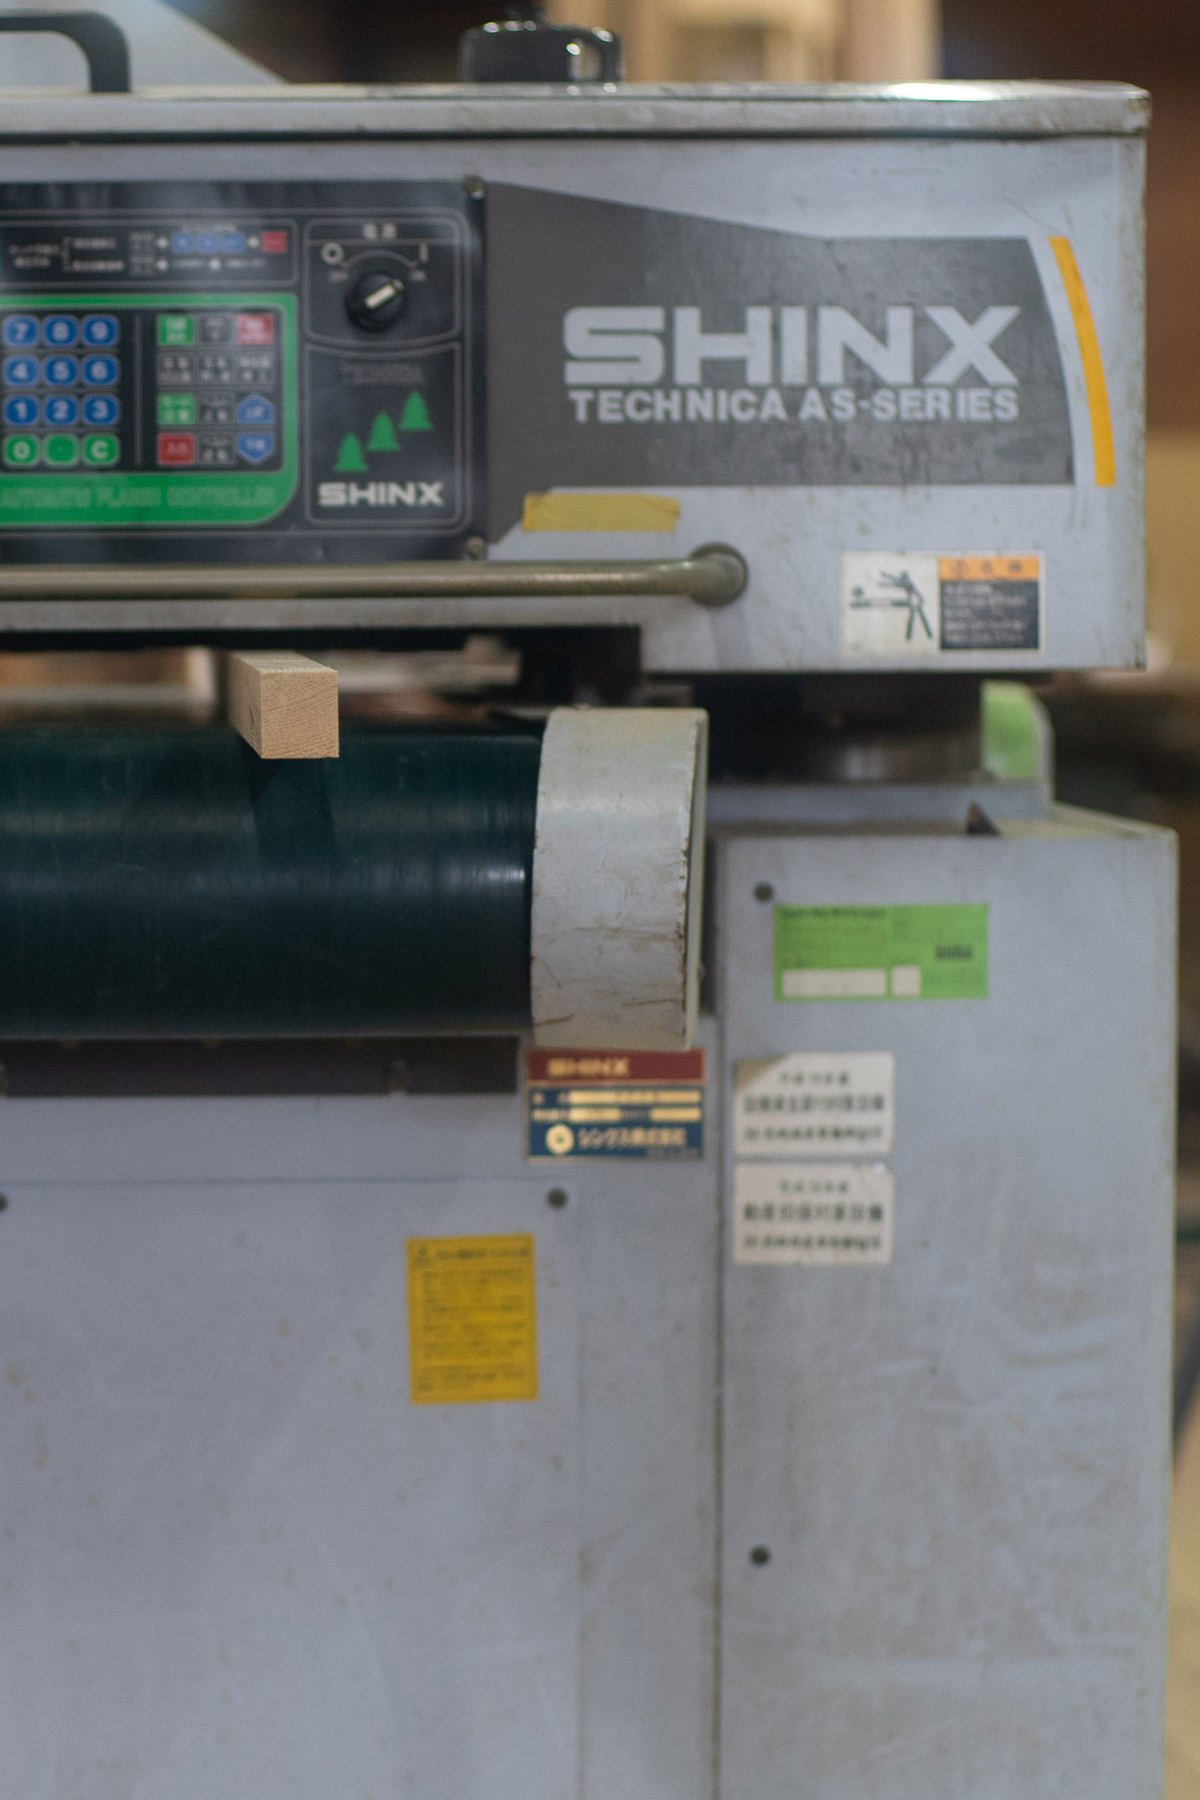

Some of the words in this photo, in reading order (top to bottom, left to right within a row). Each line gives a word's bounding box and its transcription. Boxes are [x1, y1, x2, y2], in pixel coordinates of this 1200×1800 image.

[14, 322, 29, 341] 7
[52, 321, 70, 342] 8
[91, 321, 109, 341] 9
[563, 305, 1020, 385] SHINX
[13, 361, 29, 380] 4
[53, 360, 70, 381] 5
[91, 361, 109, 381] 6
[15, 402, 28, 420] 1
[53, 400, 70, 421] 2
[92, 400, 109, 420] 3
[568, 387, 788, 423] TECHNICA
[799, 387, 1020, 422] AS-SERIES
[91, 440, 109, 460] C
[317, 481, 444, 506] SHINX
